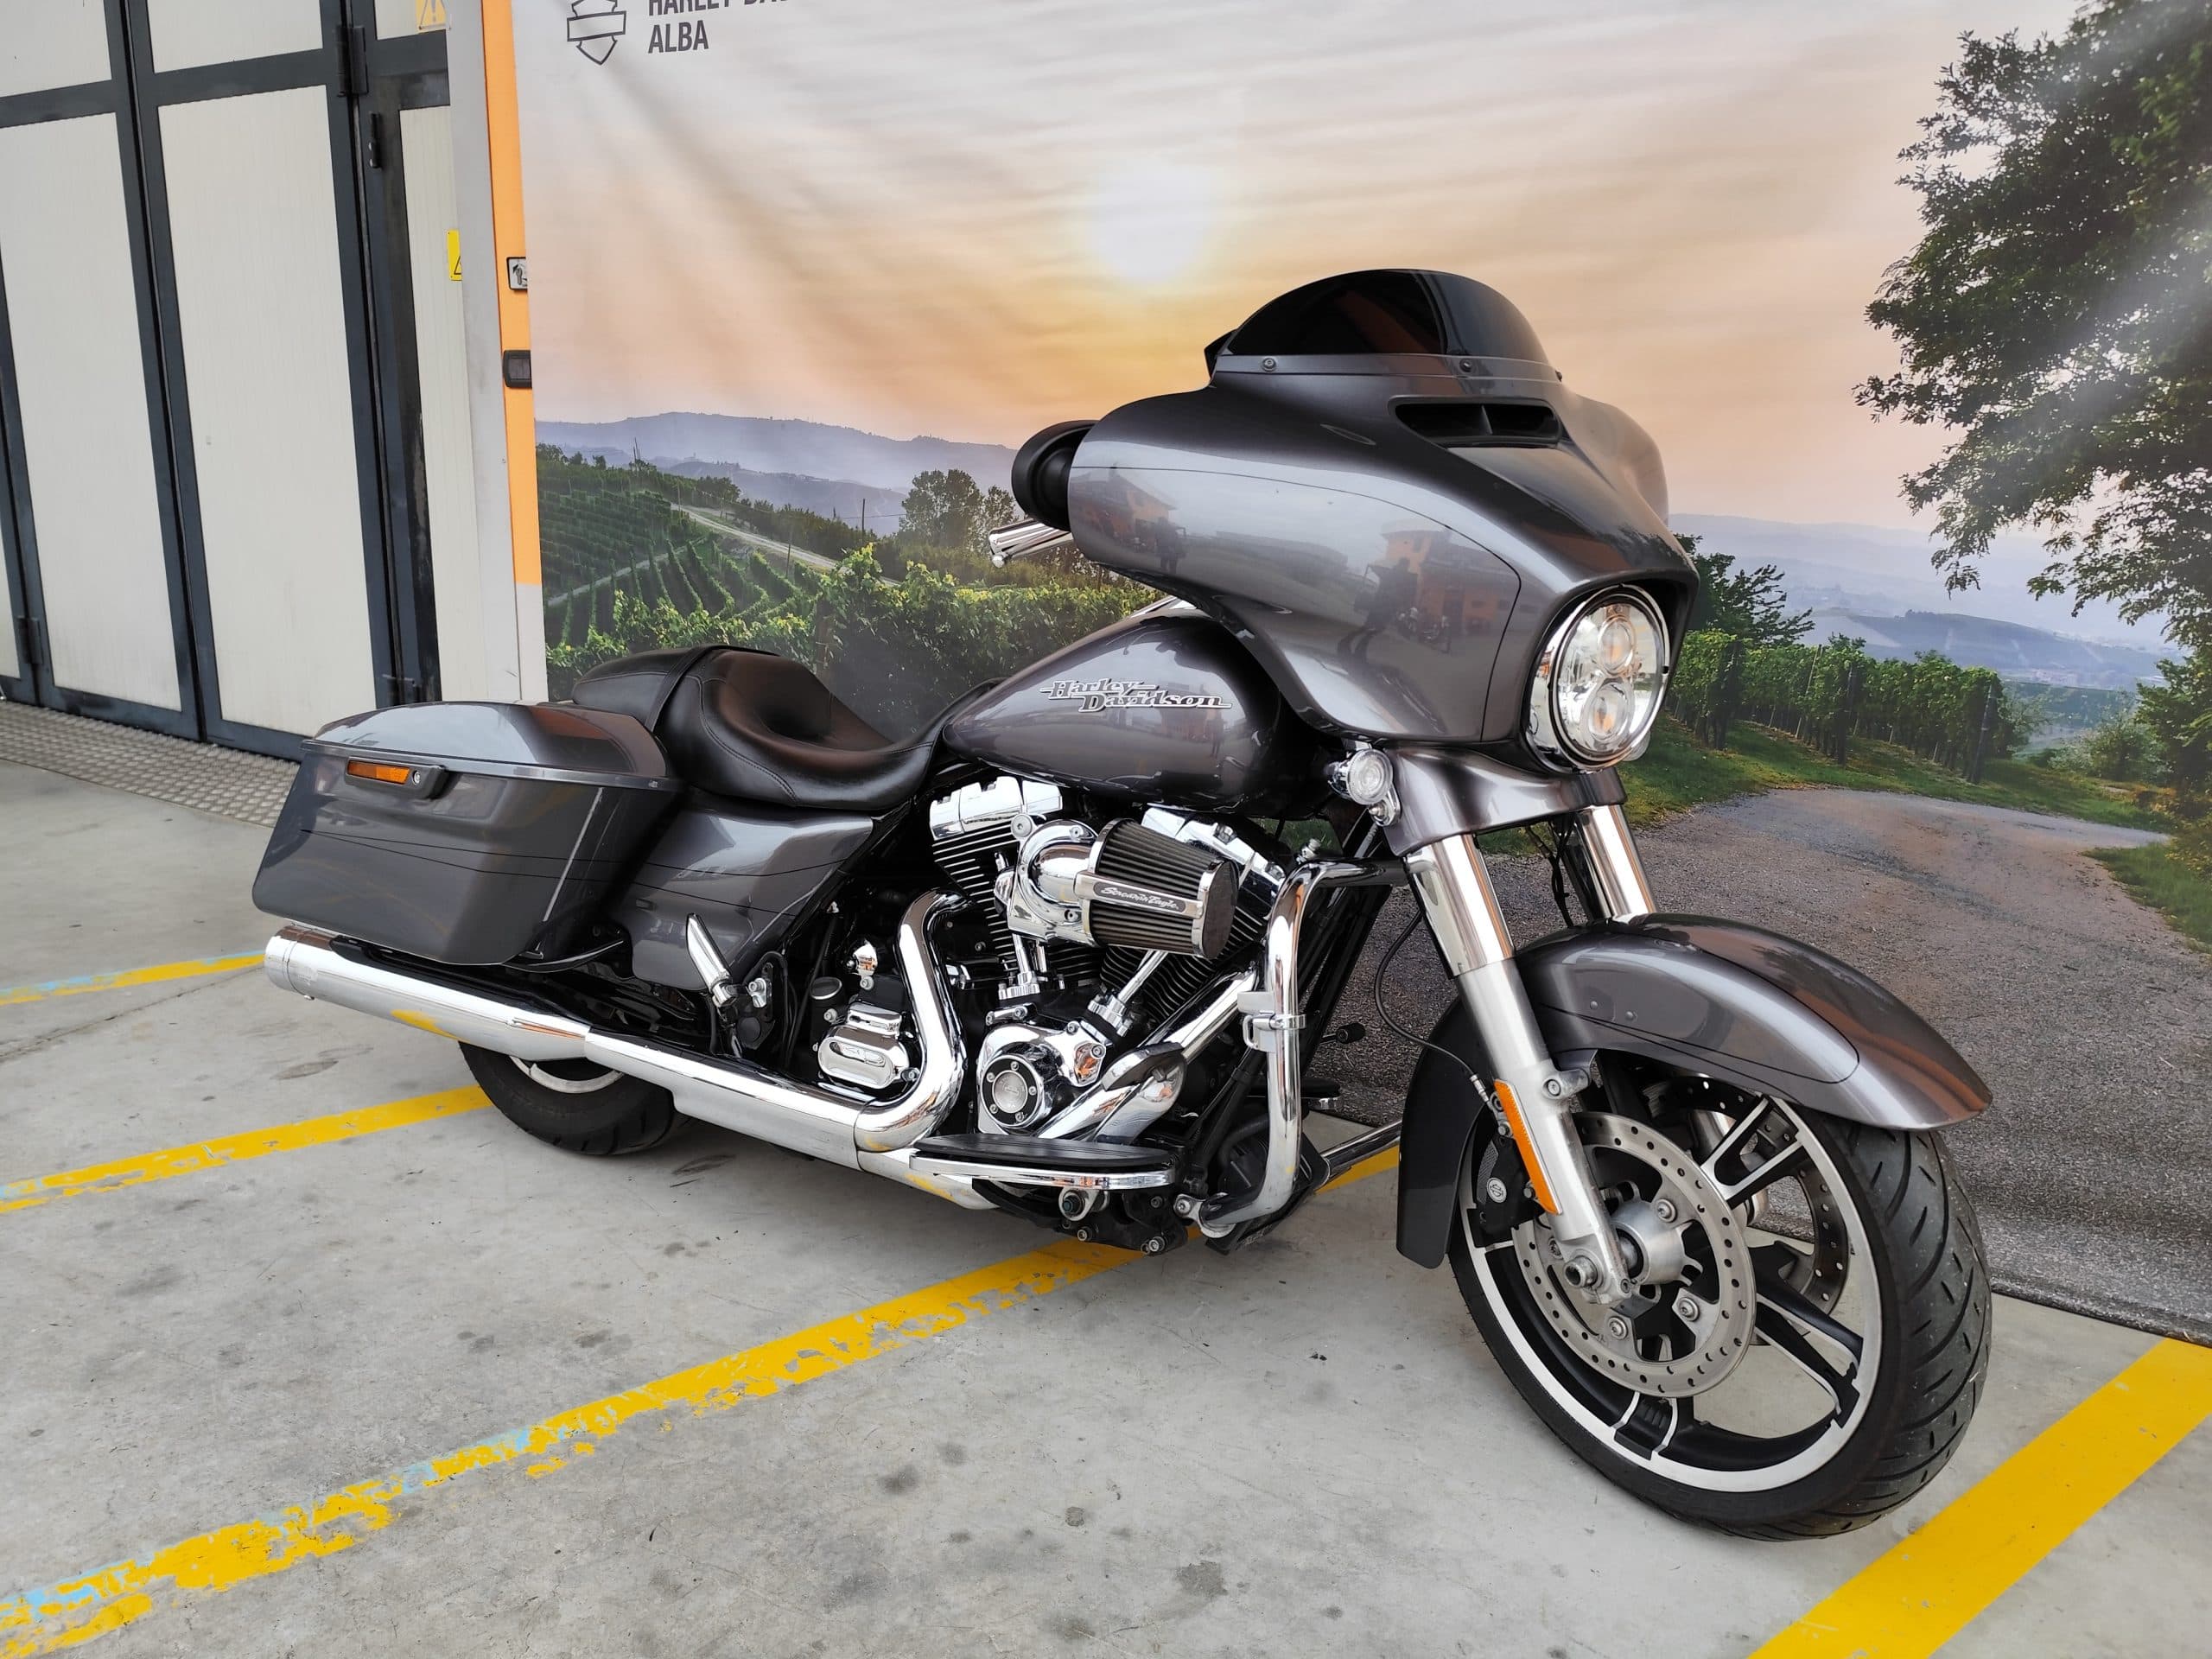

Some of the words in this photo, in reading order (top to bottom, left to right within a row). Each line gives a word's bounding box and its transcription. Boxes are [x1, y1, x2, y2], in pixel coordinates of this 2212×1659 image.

[648, 20, 709, 54] ALBA
[1039, 677, 1156, 700] Harley
[1078, 690, 1232, 712] Davidson
